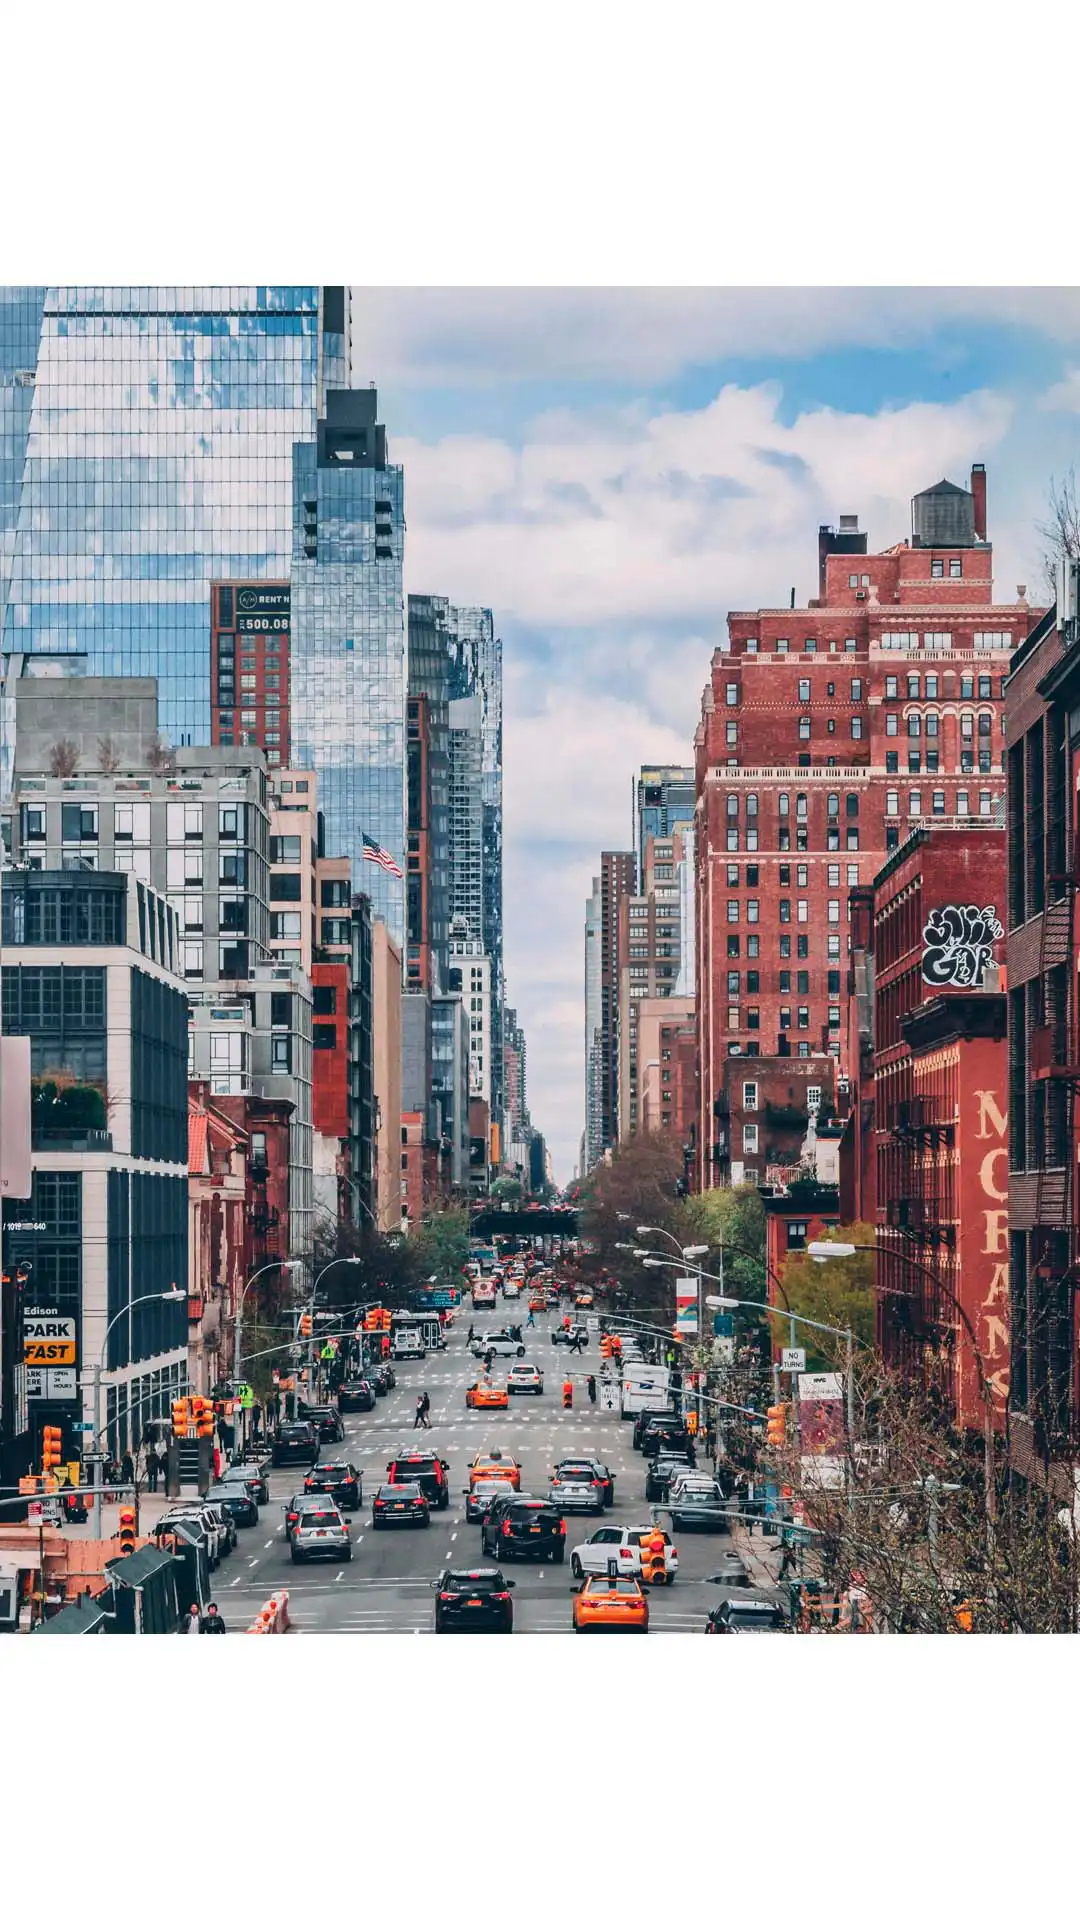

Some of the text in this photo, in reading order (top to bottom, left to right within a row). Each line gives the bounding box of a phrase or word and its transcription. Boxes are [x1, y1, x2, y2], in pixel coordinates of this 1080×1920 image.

[246, 619, 290, 629] 500.08
[24, 1307, 58, 1315] Edison
[24, 1323, 70, 1337] PARK
[24, 1345, 69, 1358] FAST
